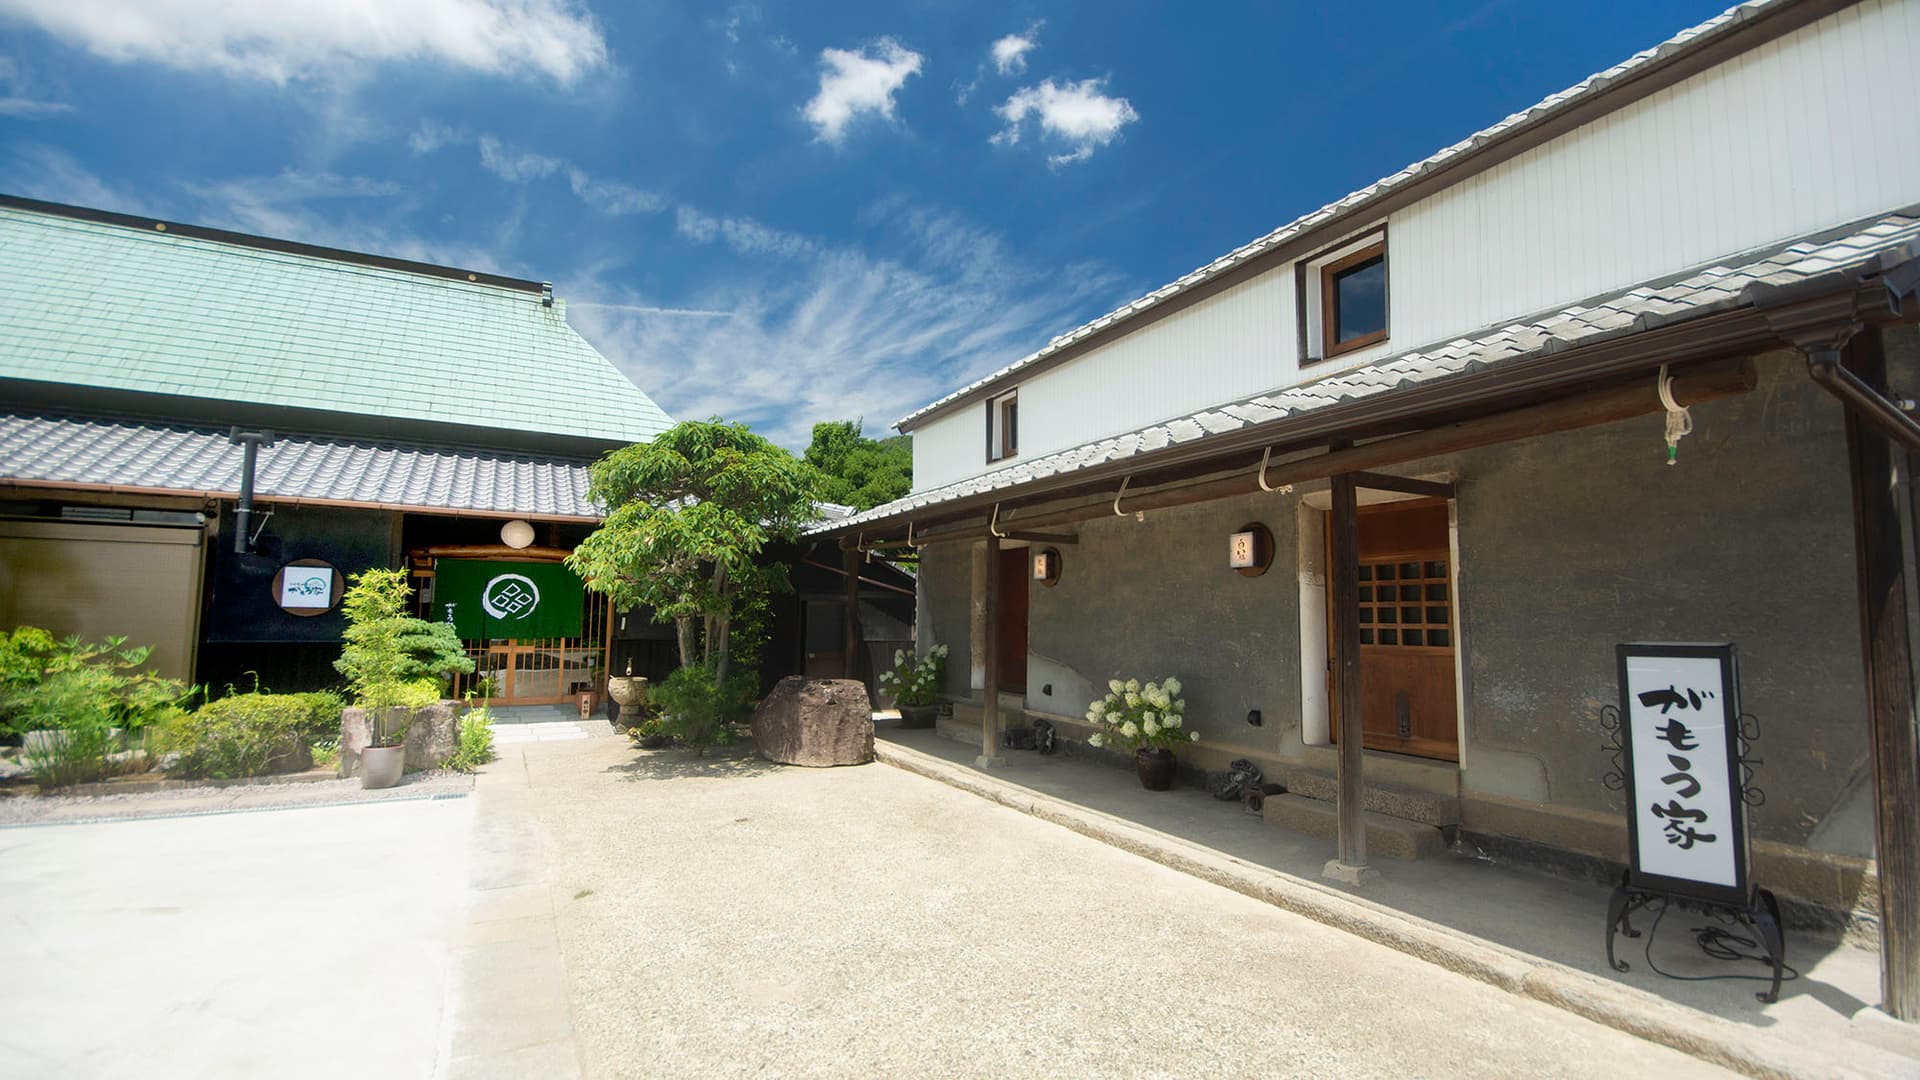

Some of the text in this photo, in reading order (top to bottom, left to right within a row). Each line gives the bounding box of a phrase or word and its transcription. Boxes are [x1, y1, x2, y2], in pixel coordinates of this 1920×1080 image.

[444, 602, 458, 625] がもう
[1637, 684, 1717, 850] がもう家
